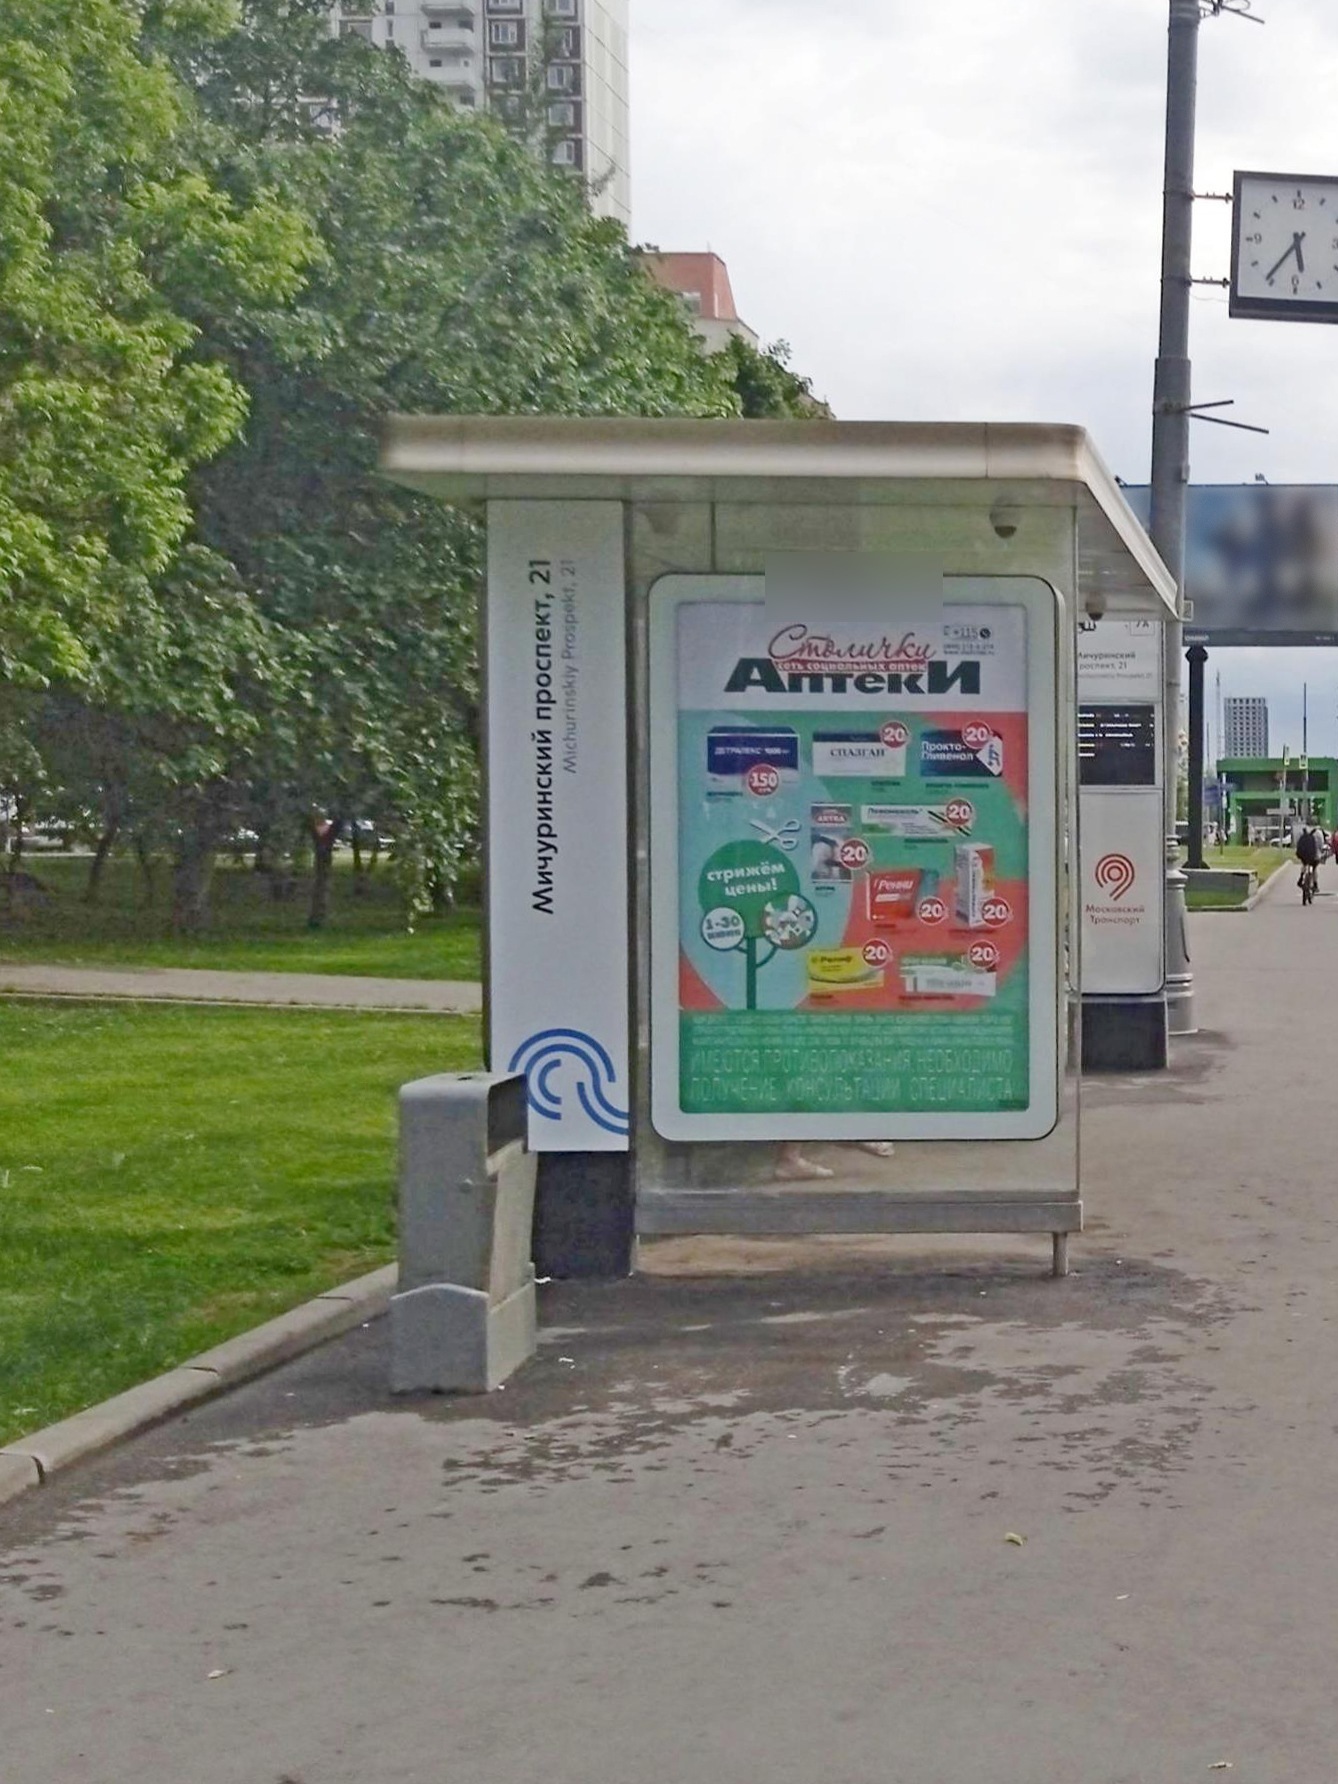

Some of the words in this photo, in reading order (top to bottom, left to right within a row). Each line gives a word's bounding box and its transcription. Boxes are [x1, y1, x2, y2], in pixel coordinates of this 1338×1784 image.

[1293, 199, 1305, 210] 12
[1254, 233, 1262, 244] 9
[1291, 274, 1299, 286] 6
[528, 560, 551, 585] 21
[560, 560, 576, 577] 21
[768, 624, 936, 659] Столички
[535, 592, 556, 720] проспект,
[778, 661, 804, 672] сеть
[807, 661, 887, 673] социальных
[889, 661, 926, 672] аптек
[561, 664, 579, 774] Michurinskiy
[830, 748, 885, 758] СПАЗГАН
[531, 730, 558, 914] Мичуринский
[706, 861, 786, 884] стрижём
[724, 877, 778, 898] цены!
[1085, 903, 1145, 914] Московский
[705, 915, 741, 931] 1-30
[1090, 915, 1140, 926] Транспорт
